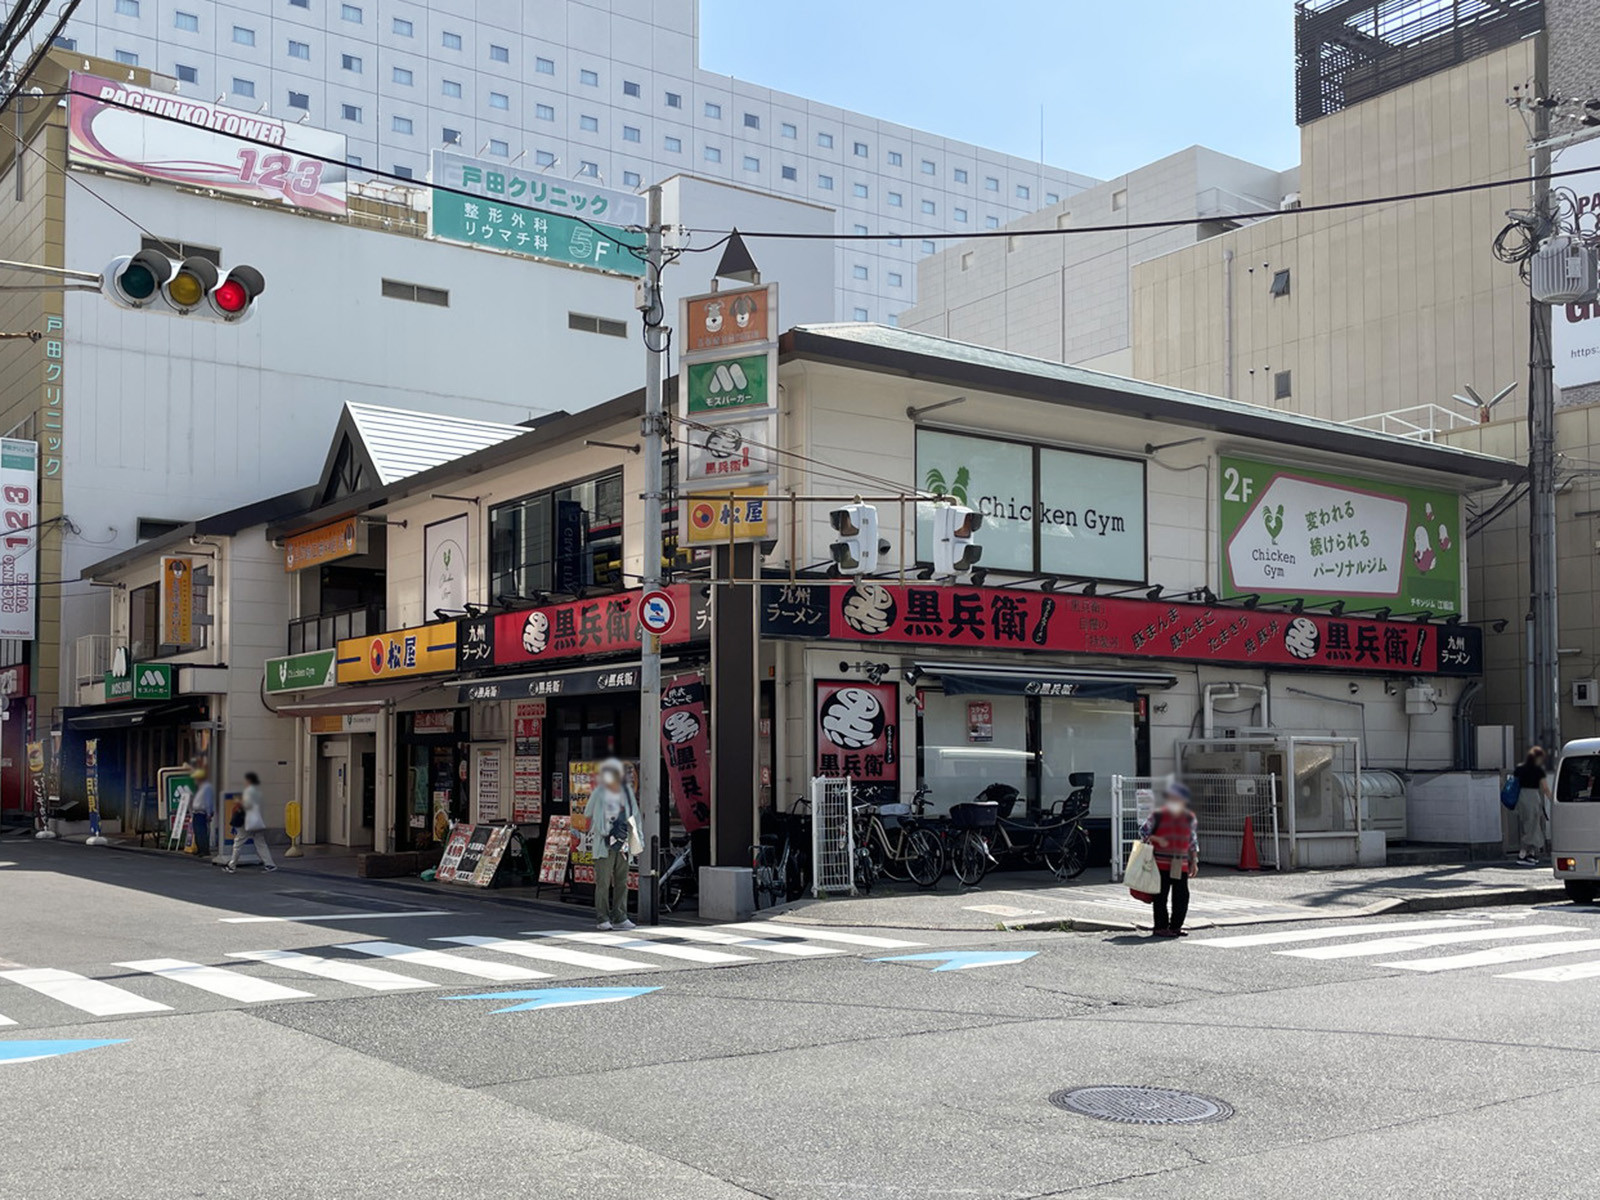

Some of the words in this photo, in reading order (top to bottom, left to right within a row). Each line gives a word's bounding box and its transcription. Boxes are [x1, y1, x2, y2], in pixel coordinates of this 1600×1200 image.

[99, 86, 211, 127] PACHINKO
[212, 111, 286, 146] TOWER
[237, 148, 323, 196] 123
[461, 165, 608, 215] 戸田クリニック
[463, 203, 549, 234] 整形外科
[465, 221, 549, 252] リウマチ科
[568, 225, 611, 262] 5F
[45, 316, 63, 476] 戸田クリニック
[705, 393, 752, 407] モスバーガー
[705, 459, 741, 476] 黒兵衛
[1223, 467, 1254, 503] 2F
[3, 485, 31, 551] 123
[719, 501, 764, 525] 松屋
[978, 496, 1078, 528] Chicken
[1084, 509, 1126, 536] Gym
[1304, 500, 1355, 532] 変われる
[1251, 548, 1296, 565] Chicken
[1309, 529, 1370, 557] 続けられる
[1263, 564, 1285, 580] Gym
[1313, 557, 1388, 579] パーソナルジム
[1, 554, 15, 614] PACHINKO
[15, 572, 29, 614] TOWER
[779, 584, 811, 605] 九州
[553, 598, 632, 651] 黒兵衛
[767, 603, 822, 625] ラーメン
[902, 588, 1029, 642] 黒兵衛
[1131, 607, 1180, 650] 豚まんま
[468, 624, 486, 643] 九州
[1325, 621, 1408, 664] 黒兵衛
[1447, 636, 1465, 650] 九州
[387, 635, 417, 669] 松屋
[462, 643, 491, 661] ラーメン
[1441, 651, 1471, 666] ラーメン
[819, 752, 884, 778] 黒兵衛
